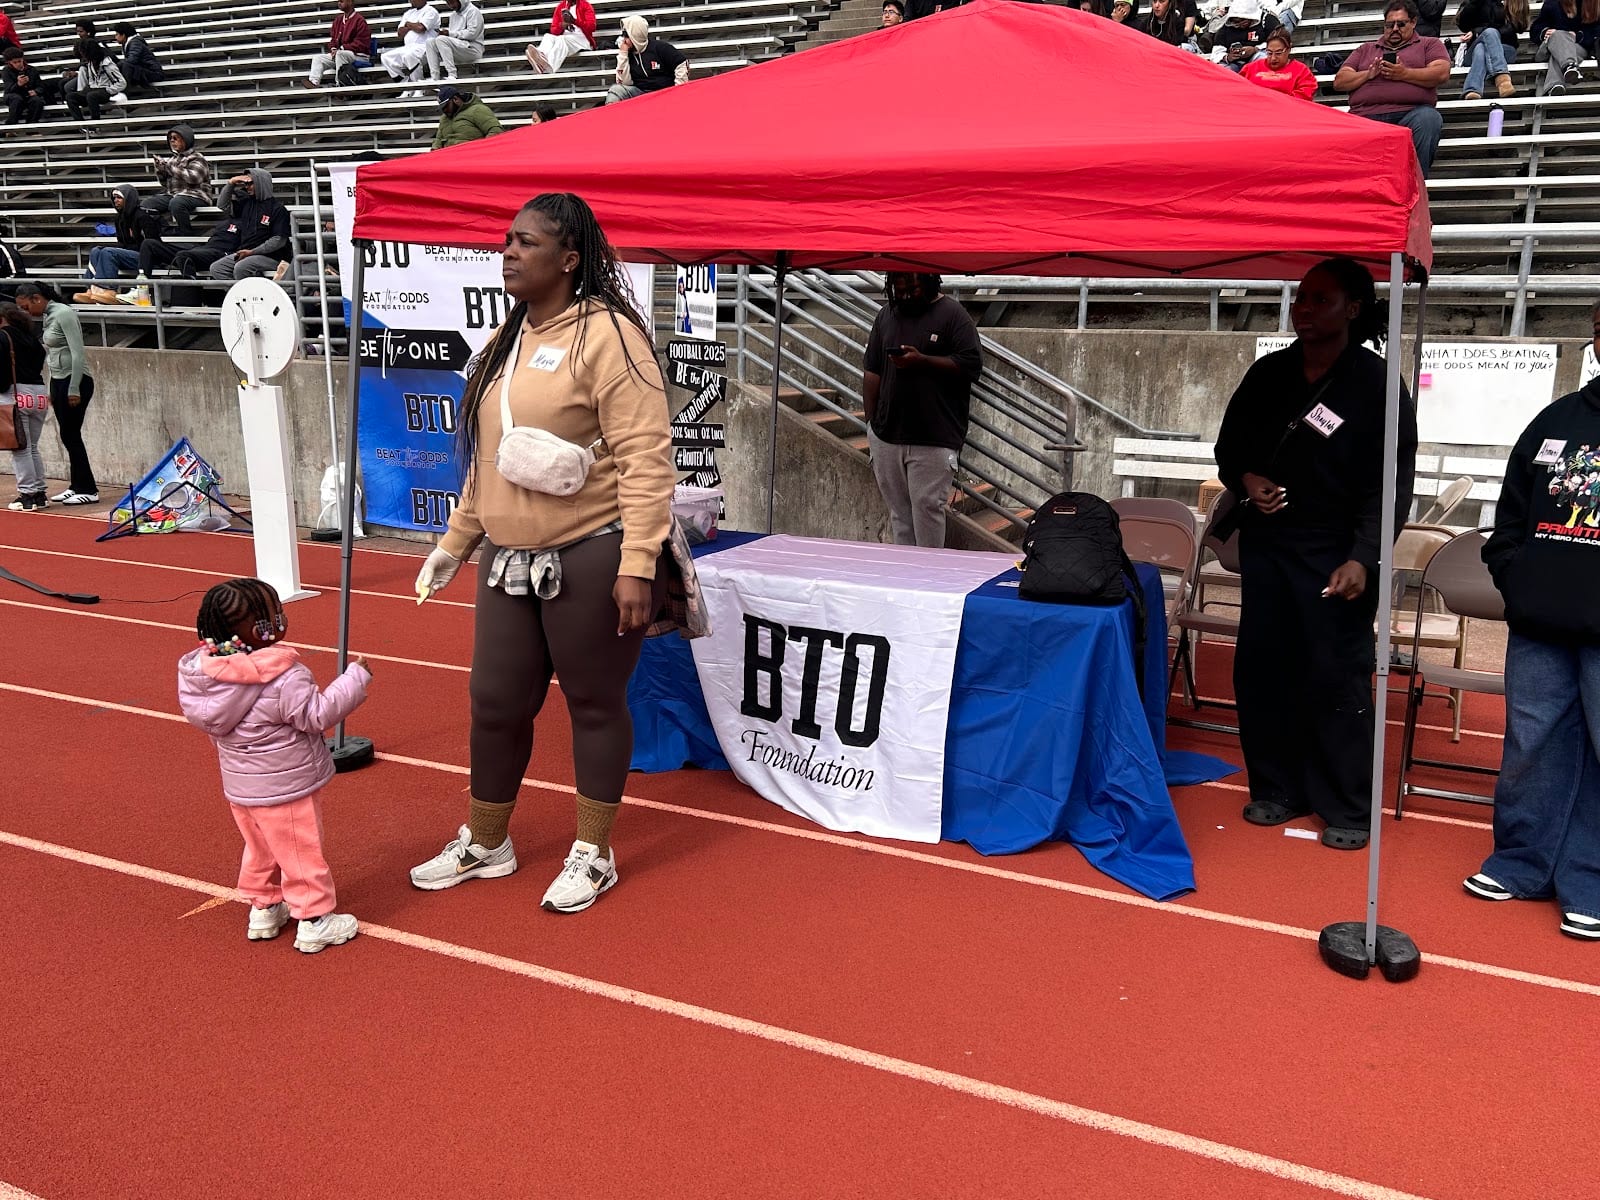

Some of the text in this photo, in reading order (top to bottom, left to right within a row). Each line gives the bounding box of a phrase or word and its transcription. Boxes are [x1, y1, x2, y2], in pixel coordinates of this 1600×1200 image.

[434, 255, 490, 263] FOUNDATION
[363, 291, 381, 303] EAT
[400, 292, 430, 304] ODDS
[360, 339, 379, 358] BE
[409, 341, 451, 361] ONE
[669, 343, 725, 361] FOOTBALL 2025
[1420, 348, 1459, 359] WHAT
[1464, 348, 1497, 359] DOES
[675, 362, 689, 385] BE
[1478, 362, 1509, 370] MEAN
[403, 392, 458, 434] BTO
[375, 447, 401, 460] BEAT
[419, 451, 449, 465] ODDS
[1548, 534, 1572, 543] HERO
[740, 612, 892, 749] BTO
[740, 729, 876, 792] Foundation
